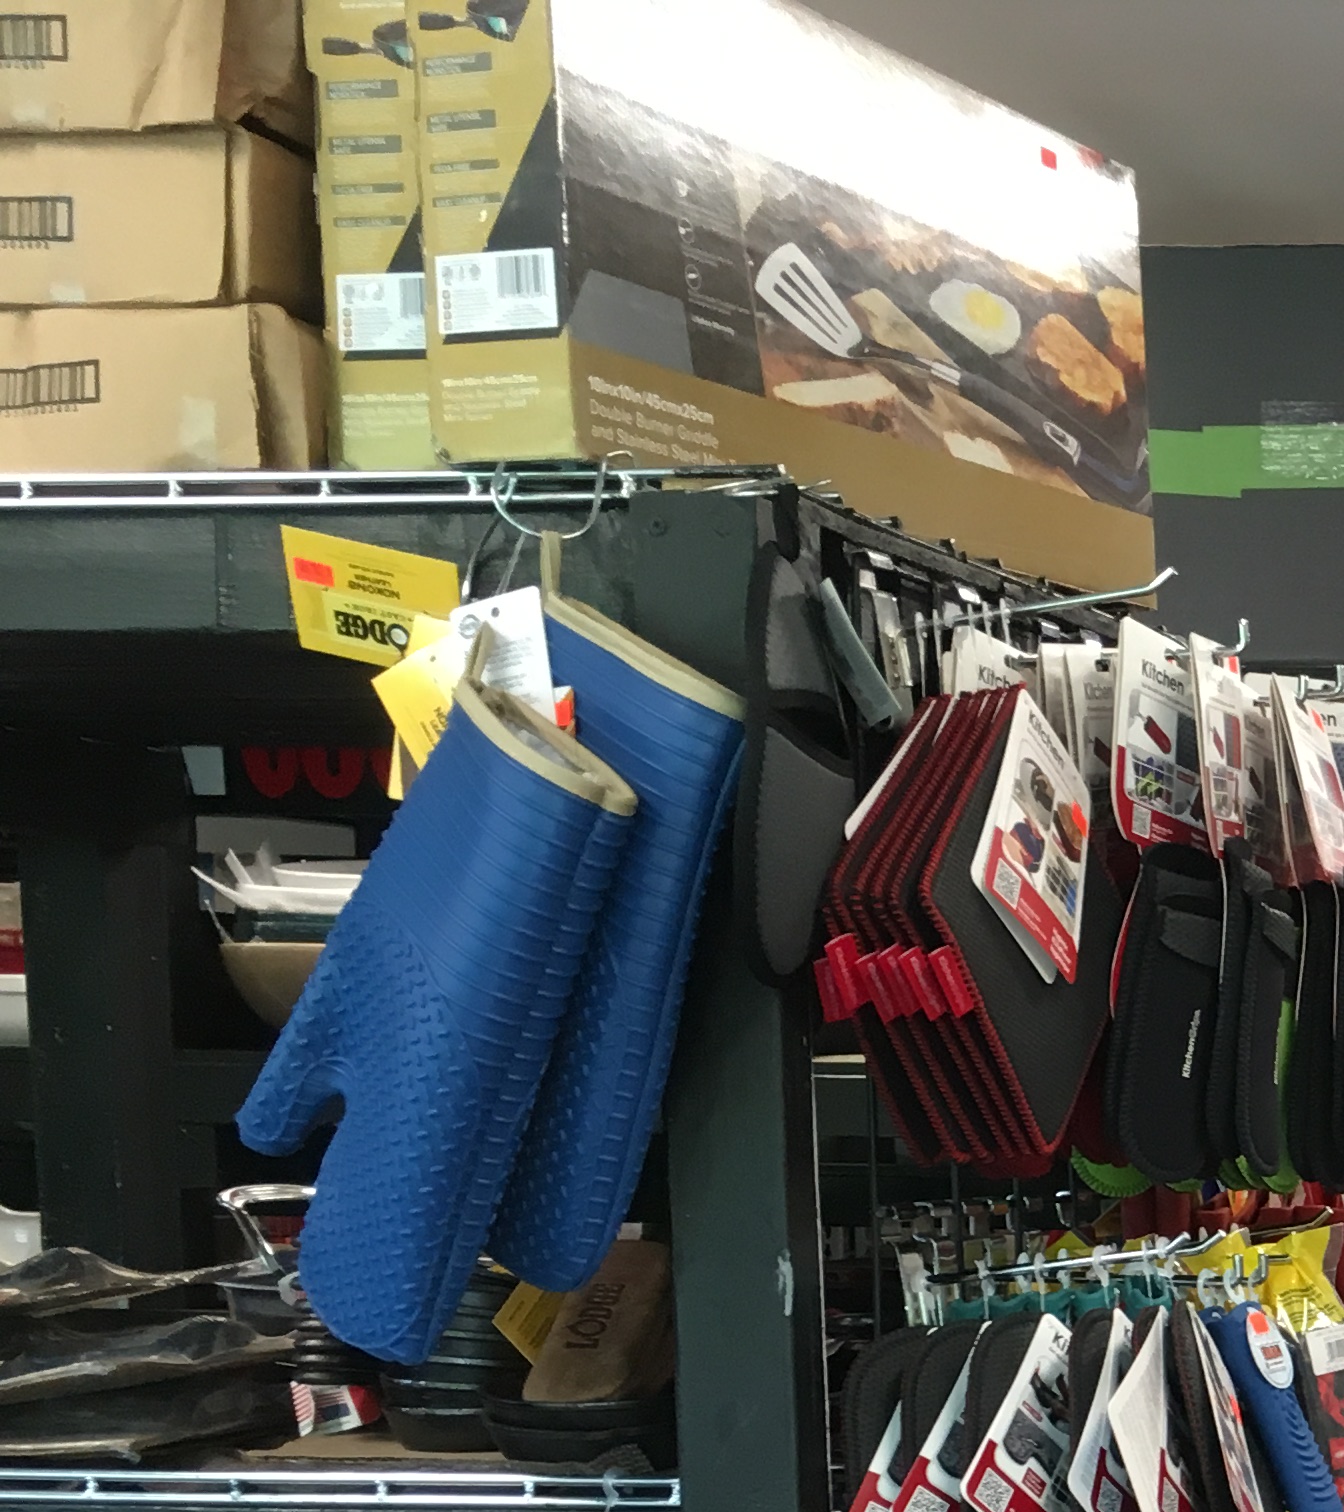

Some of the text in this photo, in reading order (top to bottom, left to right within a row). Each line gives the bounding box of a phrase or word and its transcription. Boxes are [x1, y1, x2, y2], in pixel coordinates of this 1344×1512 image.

[589, 398, 633, 427] Double
[635, 411, 677, 438] Burner
[333, 609, 411, 652] ODGE
[1141, 658, 1185, 697] Kitchen
[1028, 708, 1065, 768] Kitchen
[1181, 1008, 1202, 1080] KitchenGrips
[565, 1282, 627, 1350] LODGE
